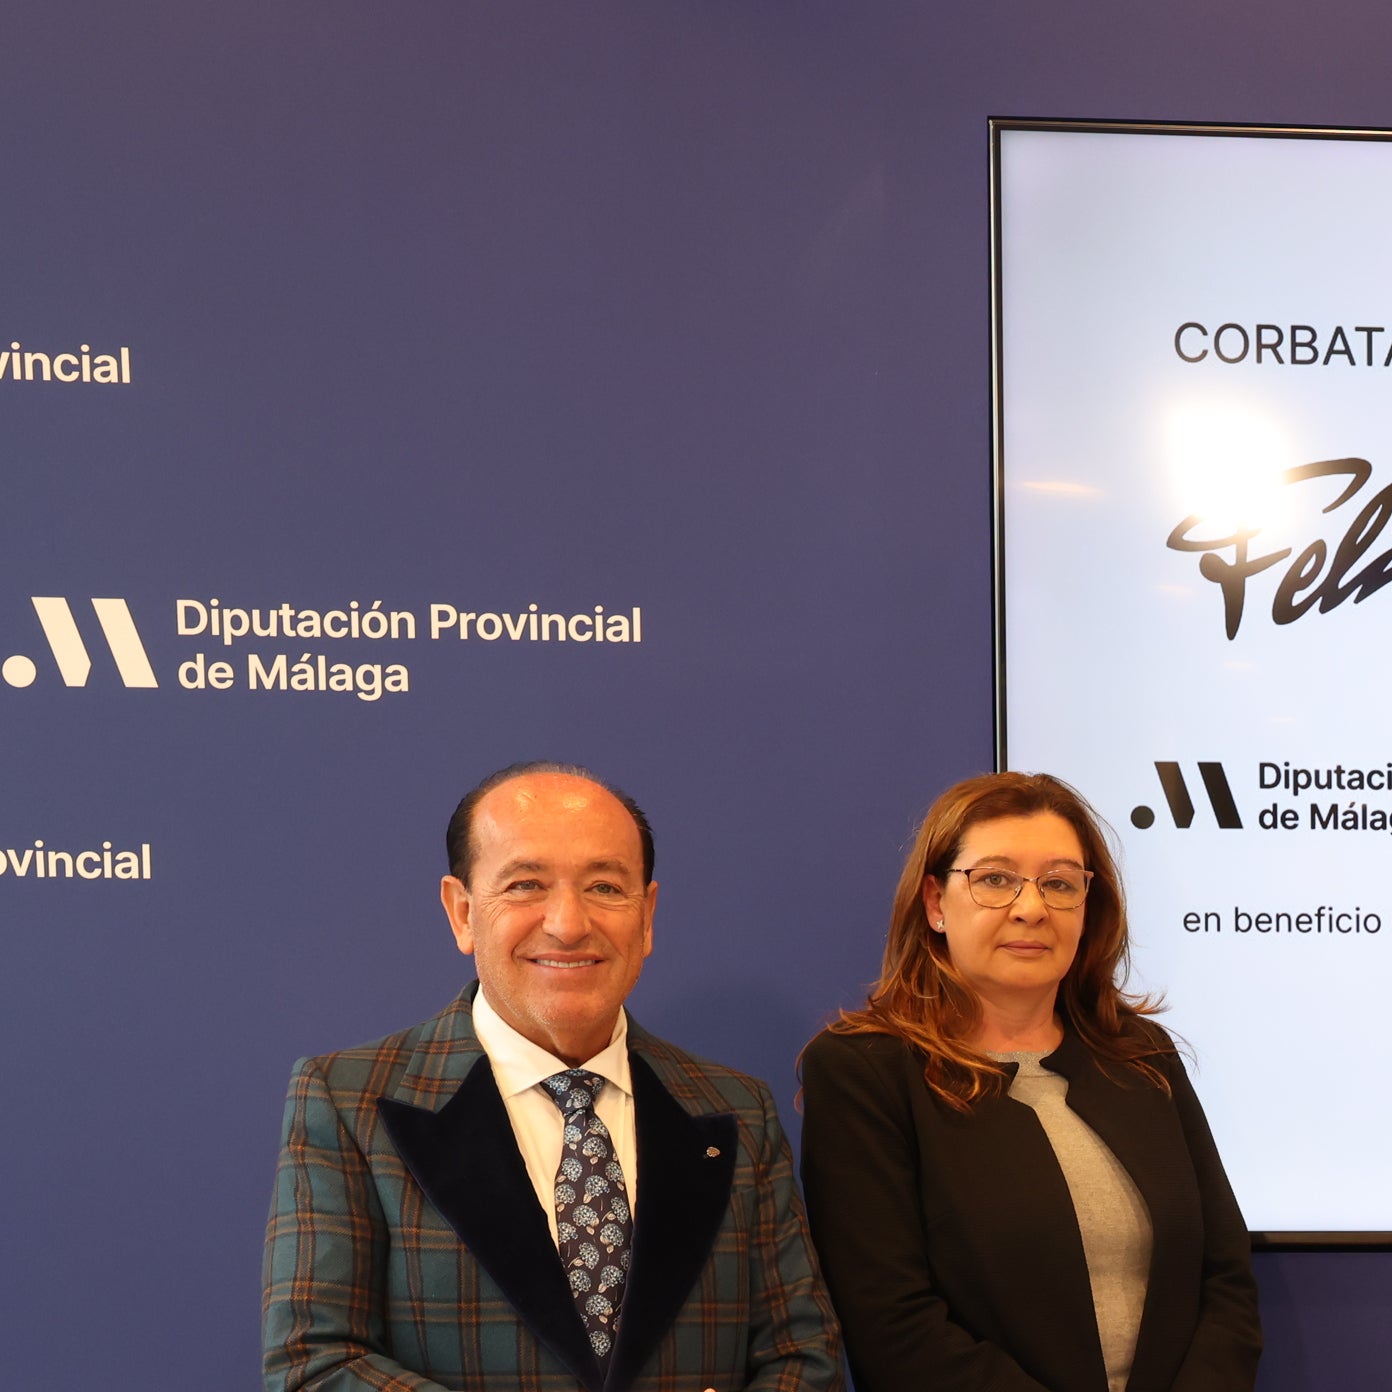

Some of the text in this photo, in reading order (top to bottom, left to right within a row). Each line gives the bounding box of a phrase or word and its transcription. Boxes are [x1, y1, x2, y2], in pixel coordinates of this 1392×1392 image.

[176, 598, 641, 646] Diputación Provincial
[178, 652, 409, 702] de Málaga
[1258, 802, 1300, 830] de
[0, 839, 151, 880] vincial
[1183, 912, 1221, 933] en
[1234, 905, 1382, 934] beneficio
